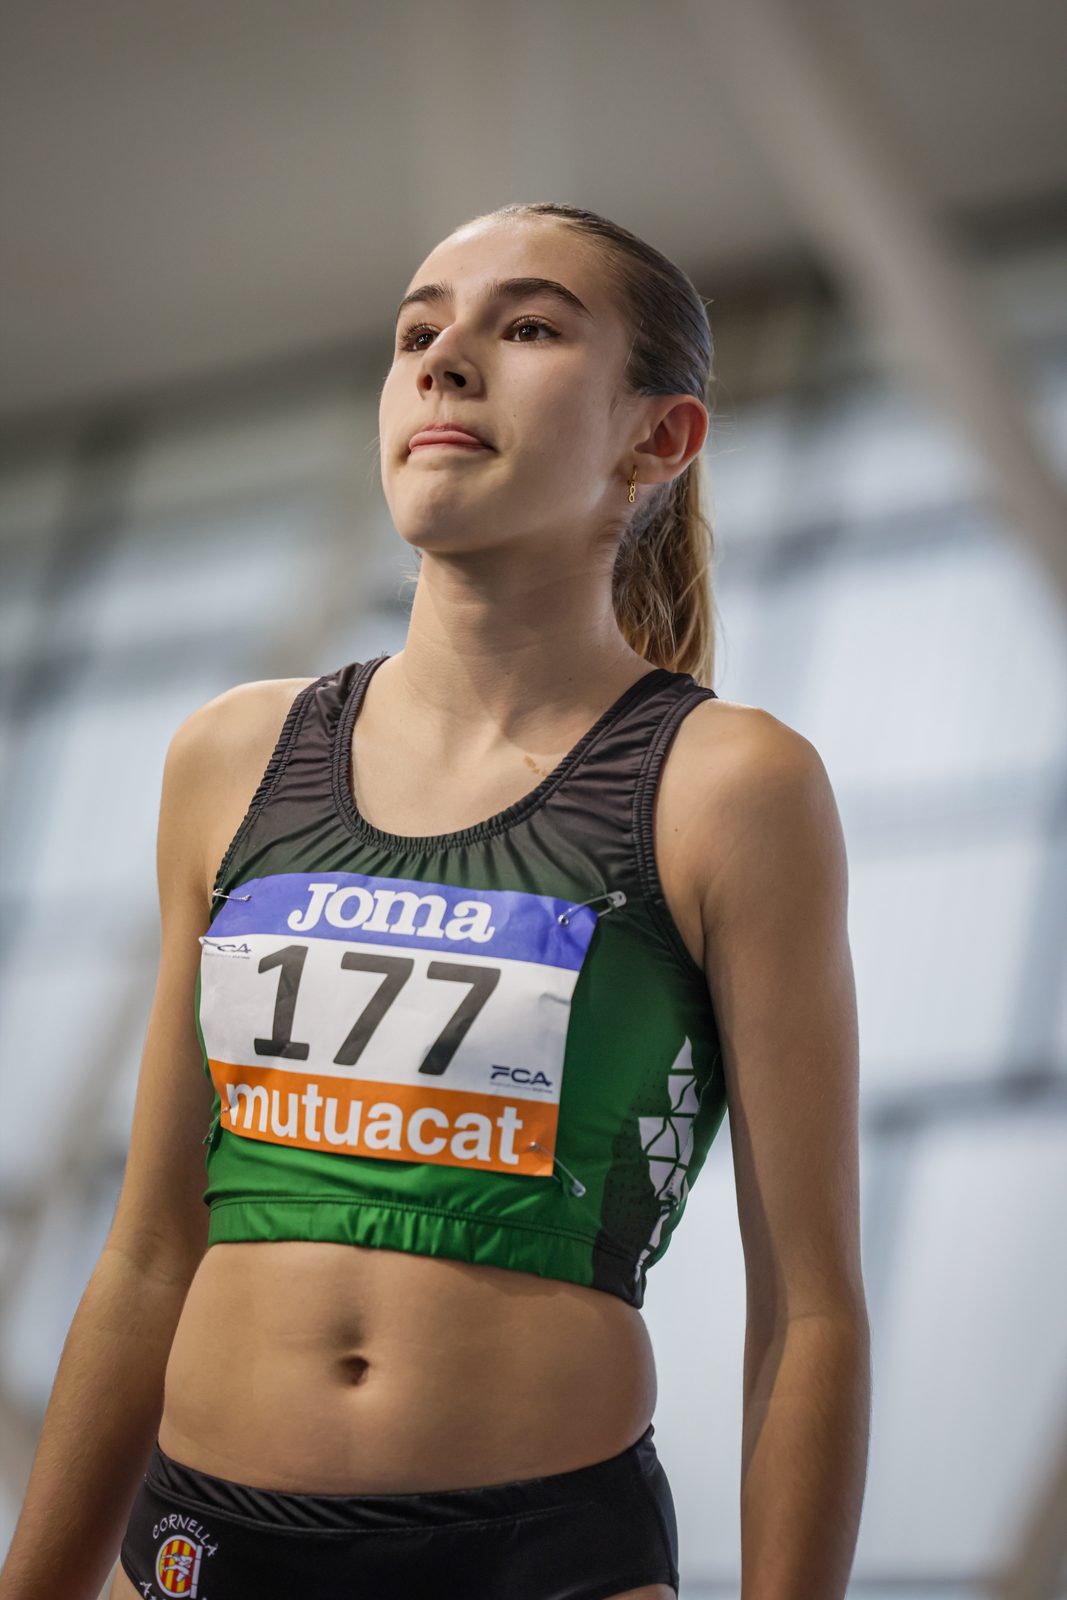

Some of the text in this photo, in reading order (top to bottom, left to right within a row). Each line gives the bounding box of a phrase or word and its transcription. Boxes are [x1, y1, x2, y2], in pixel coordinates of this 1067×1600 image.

[254, 944, 502, 1076] 177
[490, 1064, 553, 1087] FCA
[225, 1083, 523, 1165] mutuacat
